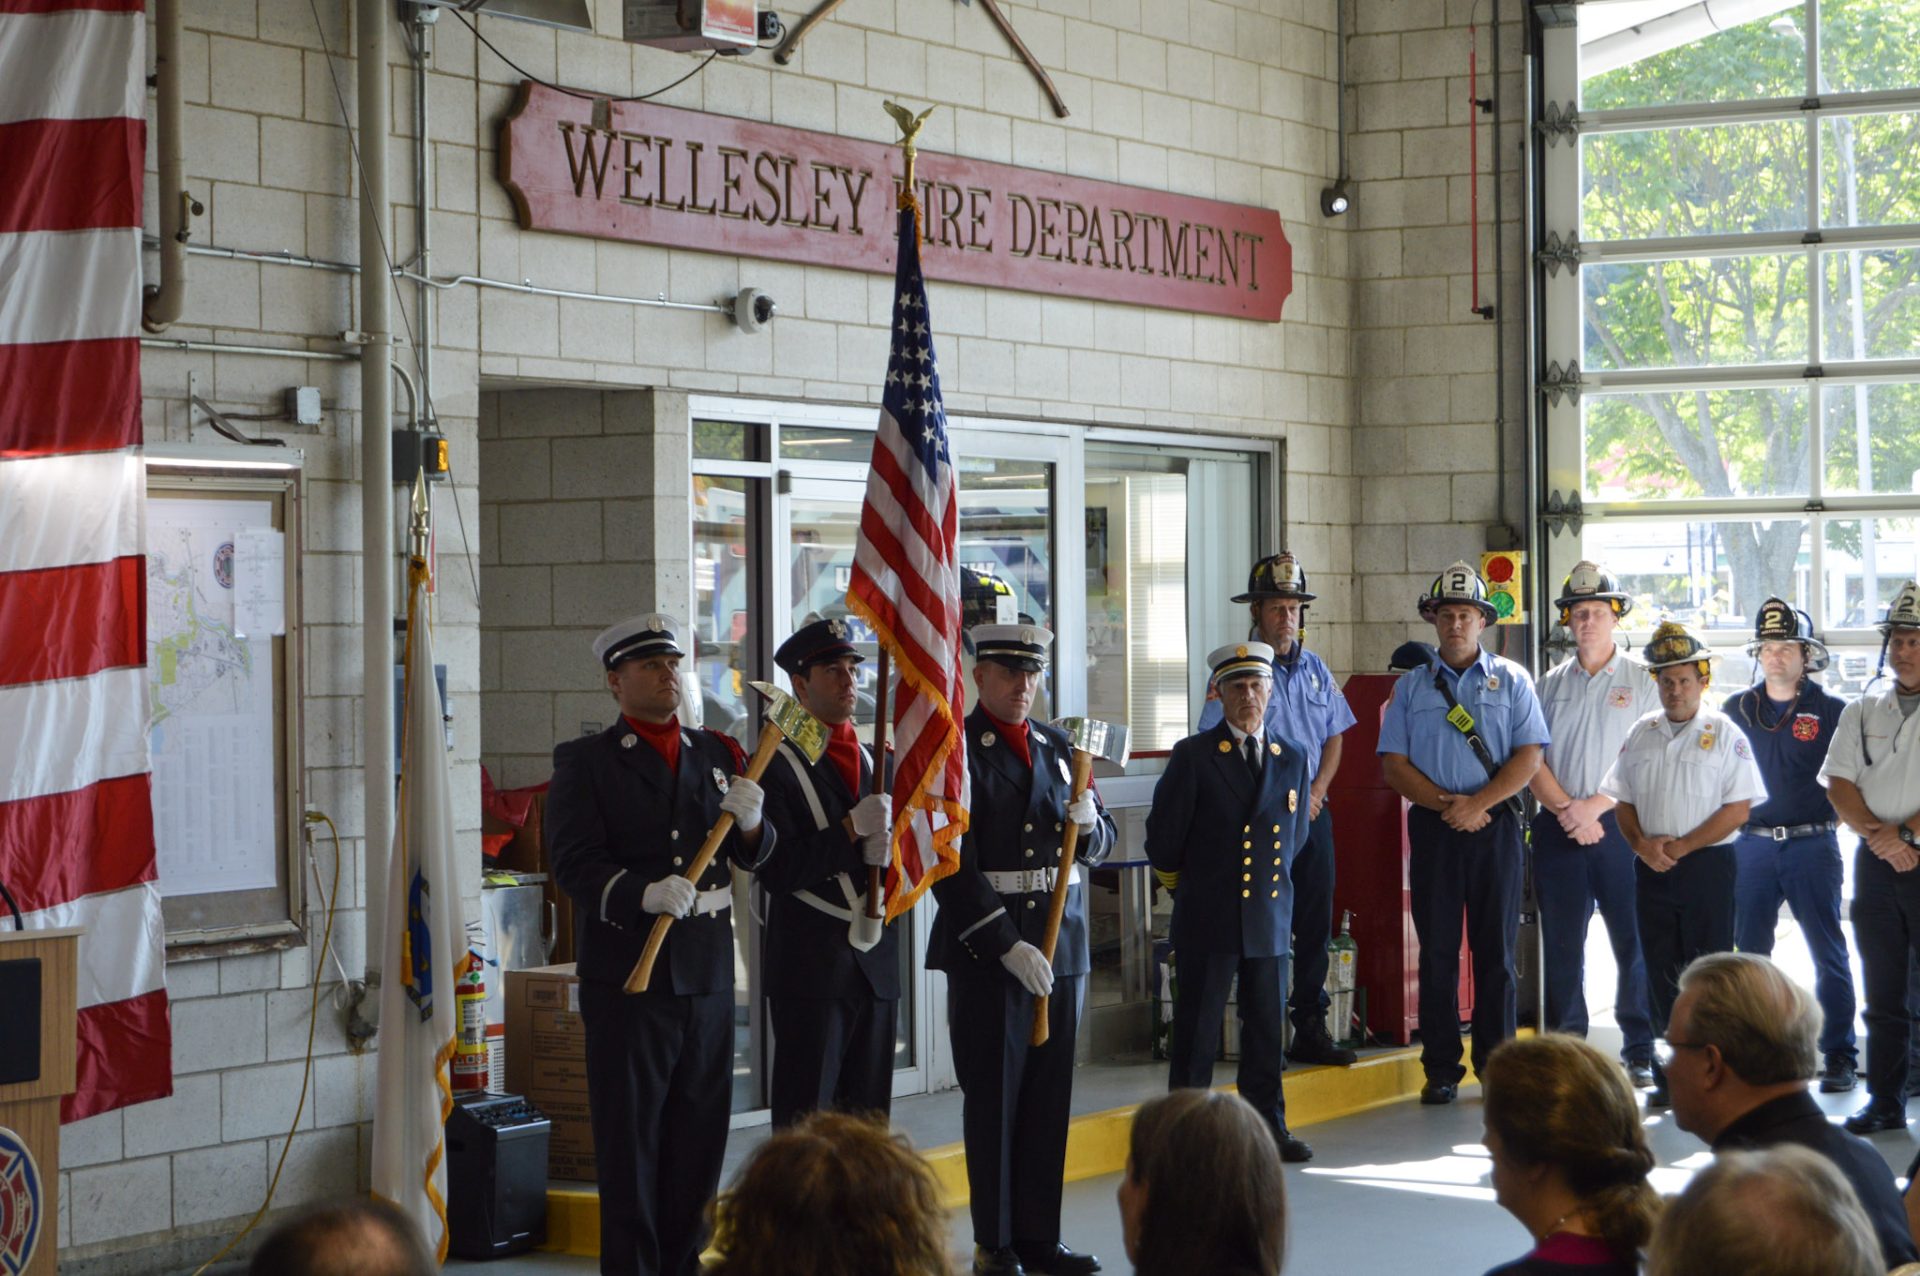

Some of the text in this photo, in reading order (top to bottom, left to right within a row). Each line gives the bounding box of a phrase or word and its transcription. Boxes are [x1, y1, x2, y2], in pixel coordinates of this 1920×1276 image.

[557, 121, 873, 235] WELLESLEY
[1007, 192, 1264, 291] DEPARTMENT
[1452, 572, 1466, 591] 2
[1897, 595, 1915, 613] 2
[1765, 610, 1781, 629] 2
